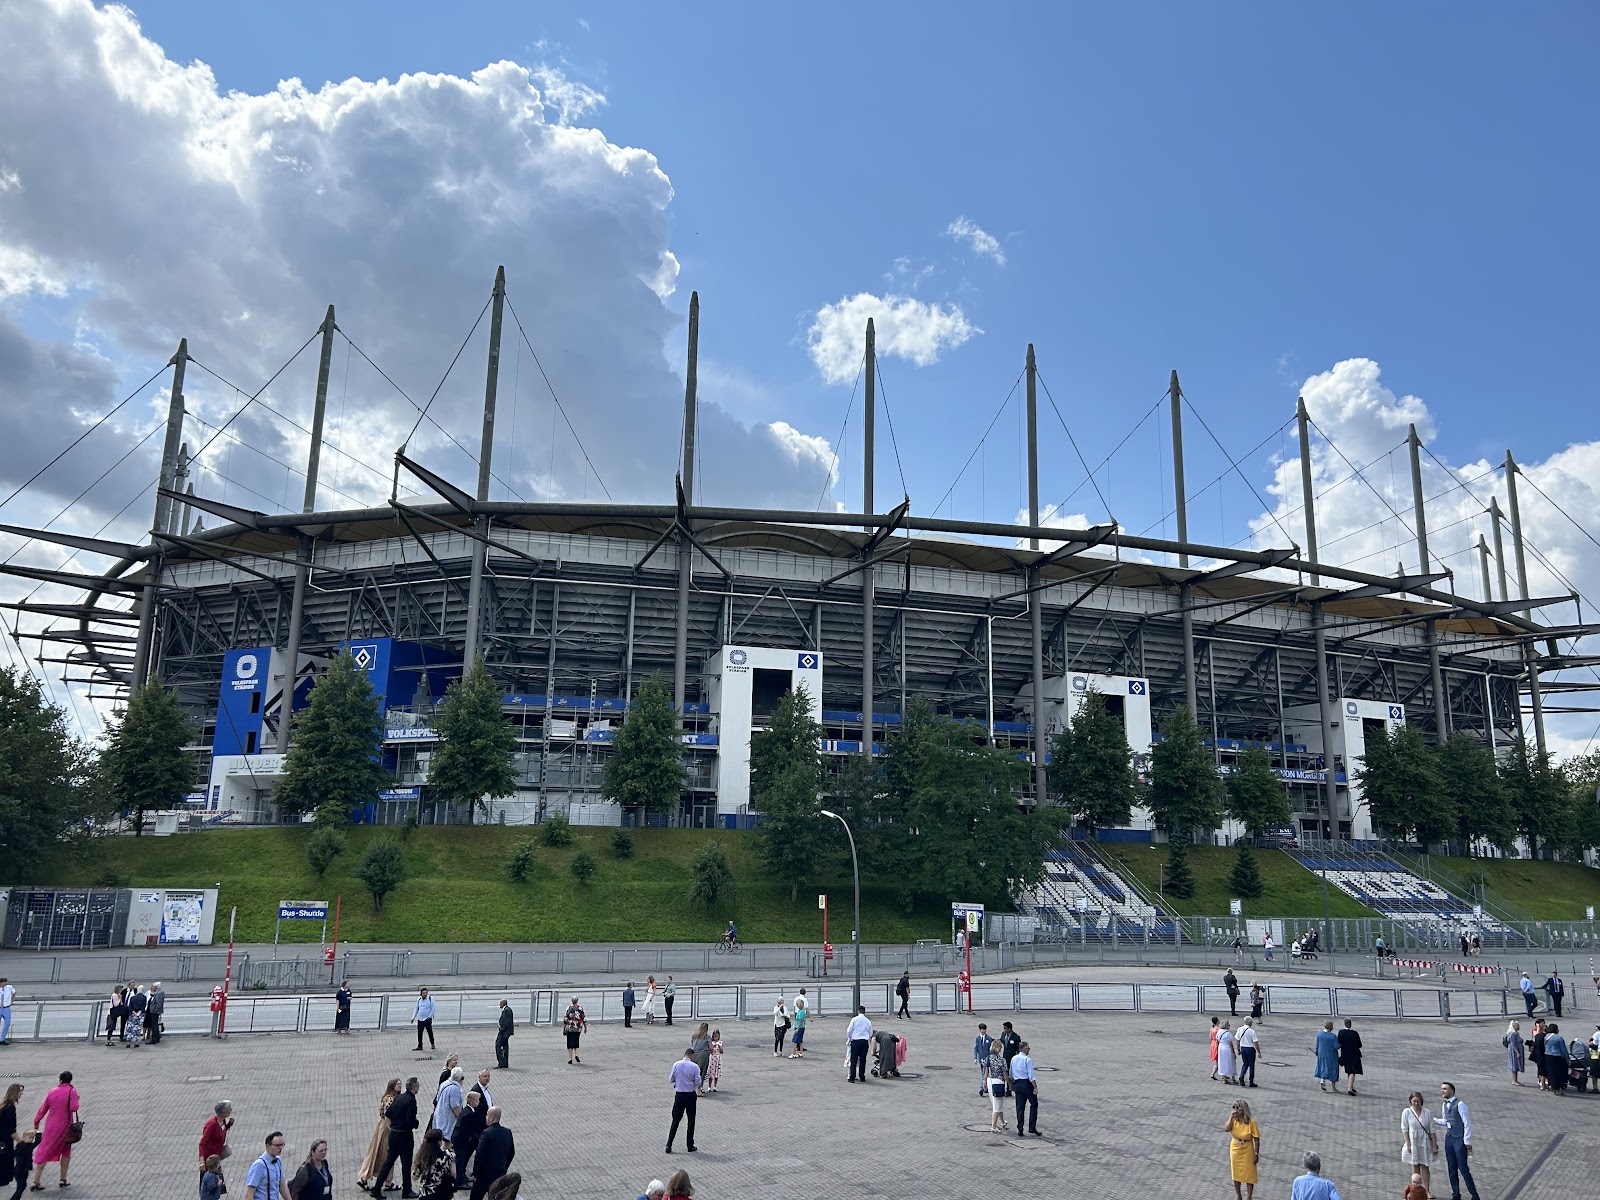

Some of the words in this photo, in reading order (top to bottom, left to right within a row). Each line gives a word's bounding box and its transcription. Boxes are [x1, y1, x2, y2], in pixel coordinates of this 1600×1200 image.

[229, 757, 253, 769] NUR
[255, 757, 279, 769] DER
[281, 909, 325, 917] Bus-Shuttle
